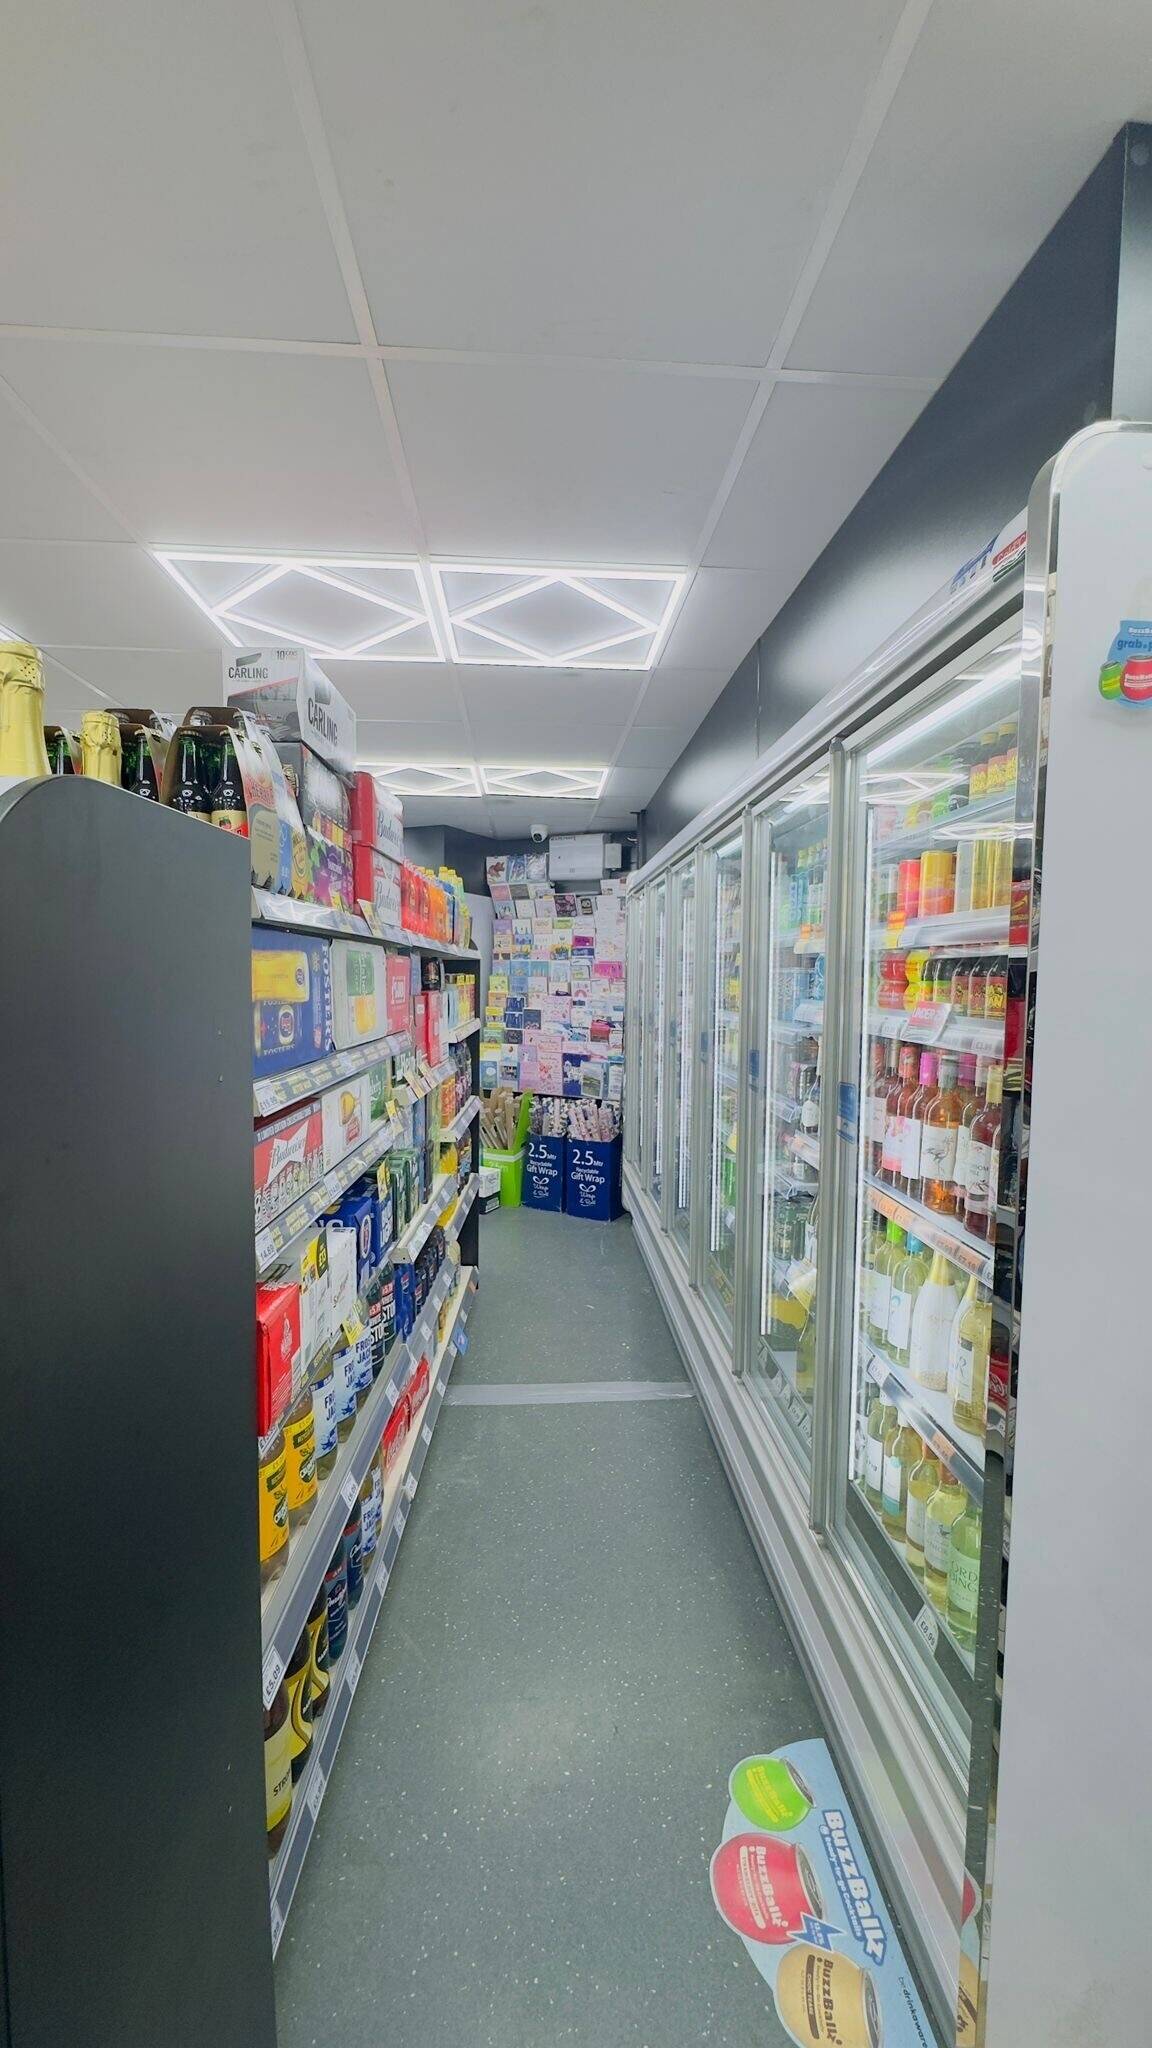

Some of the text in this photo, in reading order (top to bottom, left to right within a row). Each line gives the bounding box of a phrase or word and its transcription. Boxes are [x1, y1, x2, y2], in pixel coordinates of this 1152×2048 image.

[276, 650, 286, 660] 10
[1117, 639, 1142, 651] grab
[228, 666, 269, 679] CARLING
[307, 697, 338, 748] CARLING
[526, 1163, 558, 1177] Gift Wrap
[570, 1171, 606, 1185] Gift Wrap
[265, 1664, 281, 1696] £5.09
[755, 1846, 785, 1928] BuzzBallz
[823, 1810, 886, 1962] BuzzBallz
[822, 1959, 838, 2043] BuzzBallz
